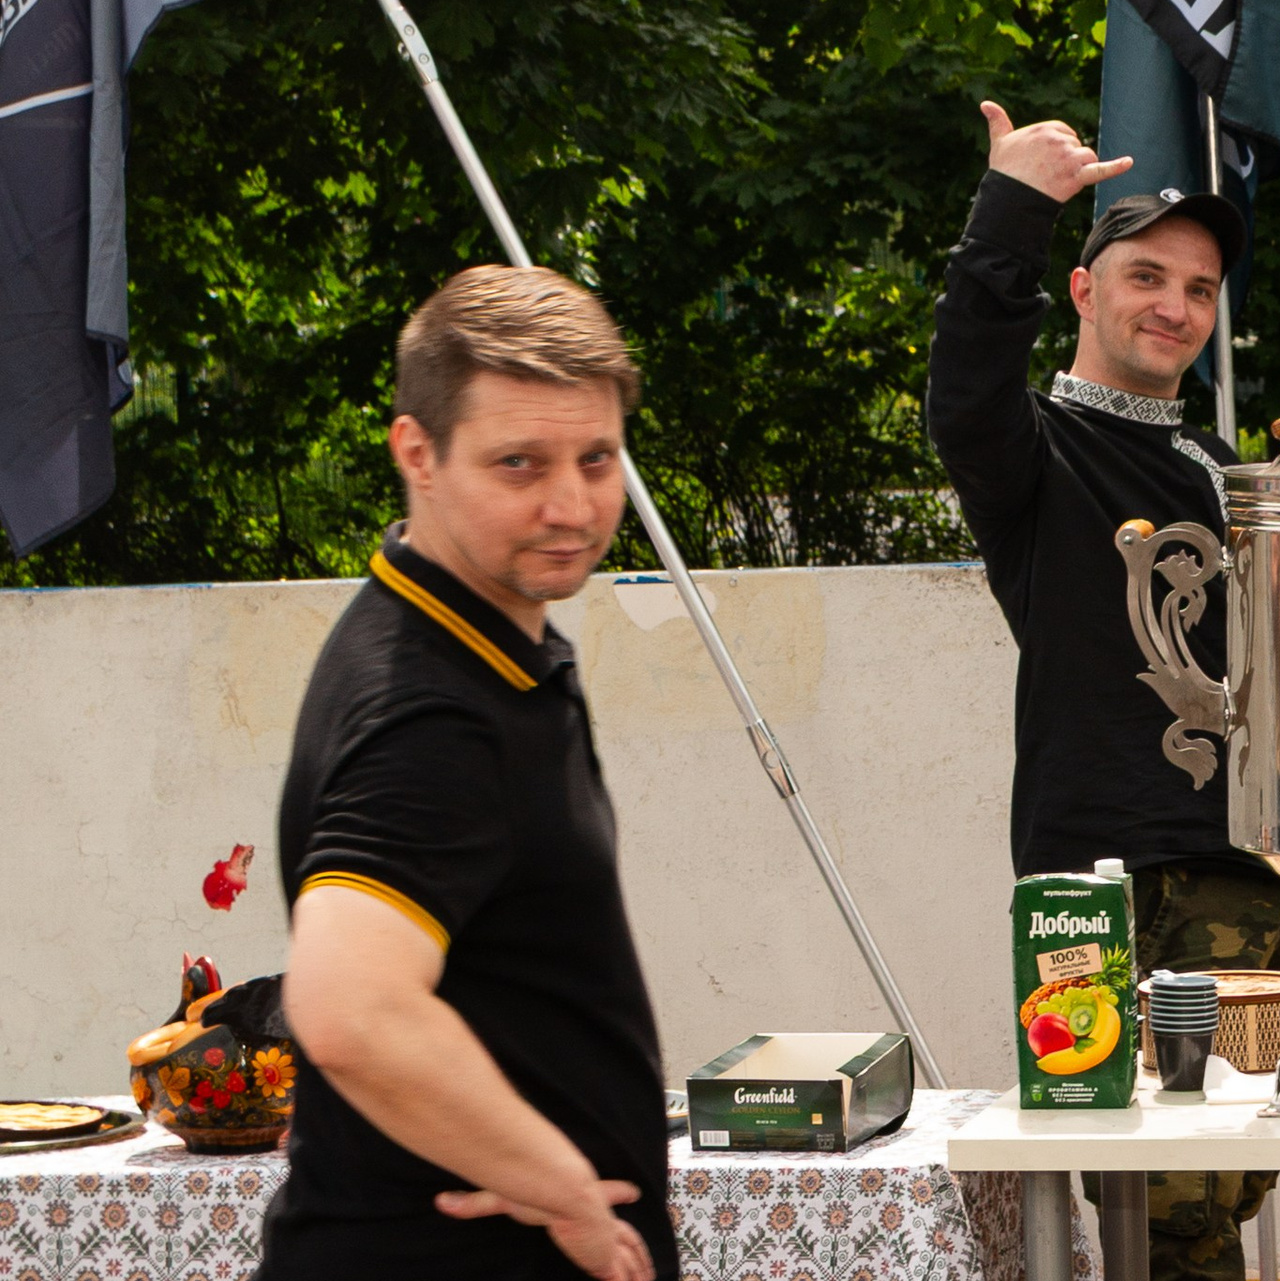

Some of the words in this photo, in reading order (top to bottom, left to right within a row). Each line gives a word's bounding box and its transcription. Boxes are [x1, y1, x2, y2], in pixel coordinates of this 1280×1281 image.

[1029, 910, 1112, 939] Добрый
[1049, 947, 1088, 966] 100%
[734, 1086, 796, 1105] Greenfield
